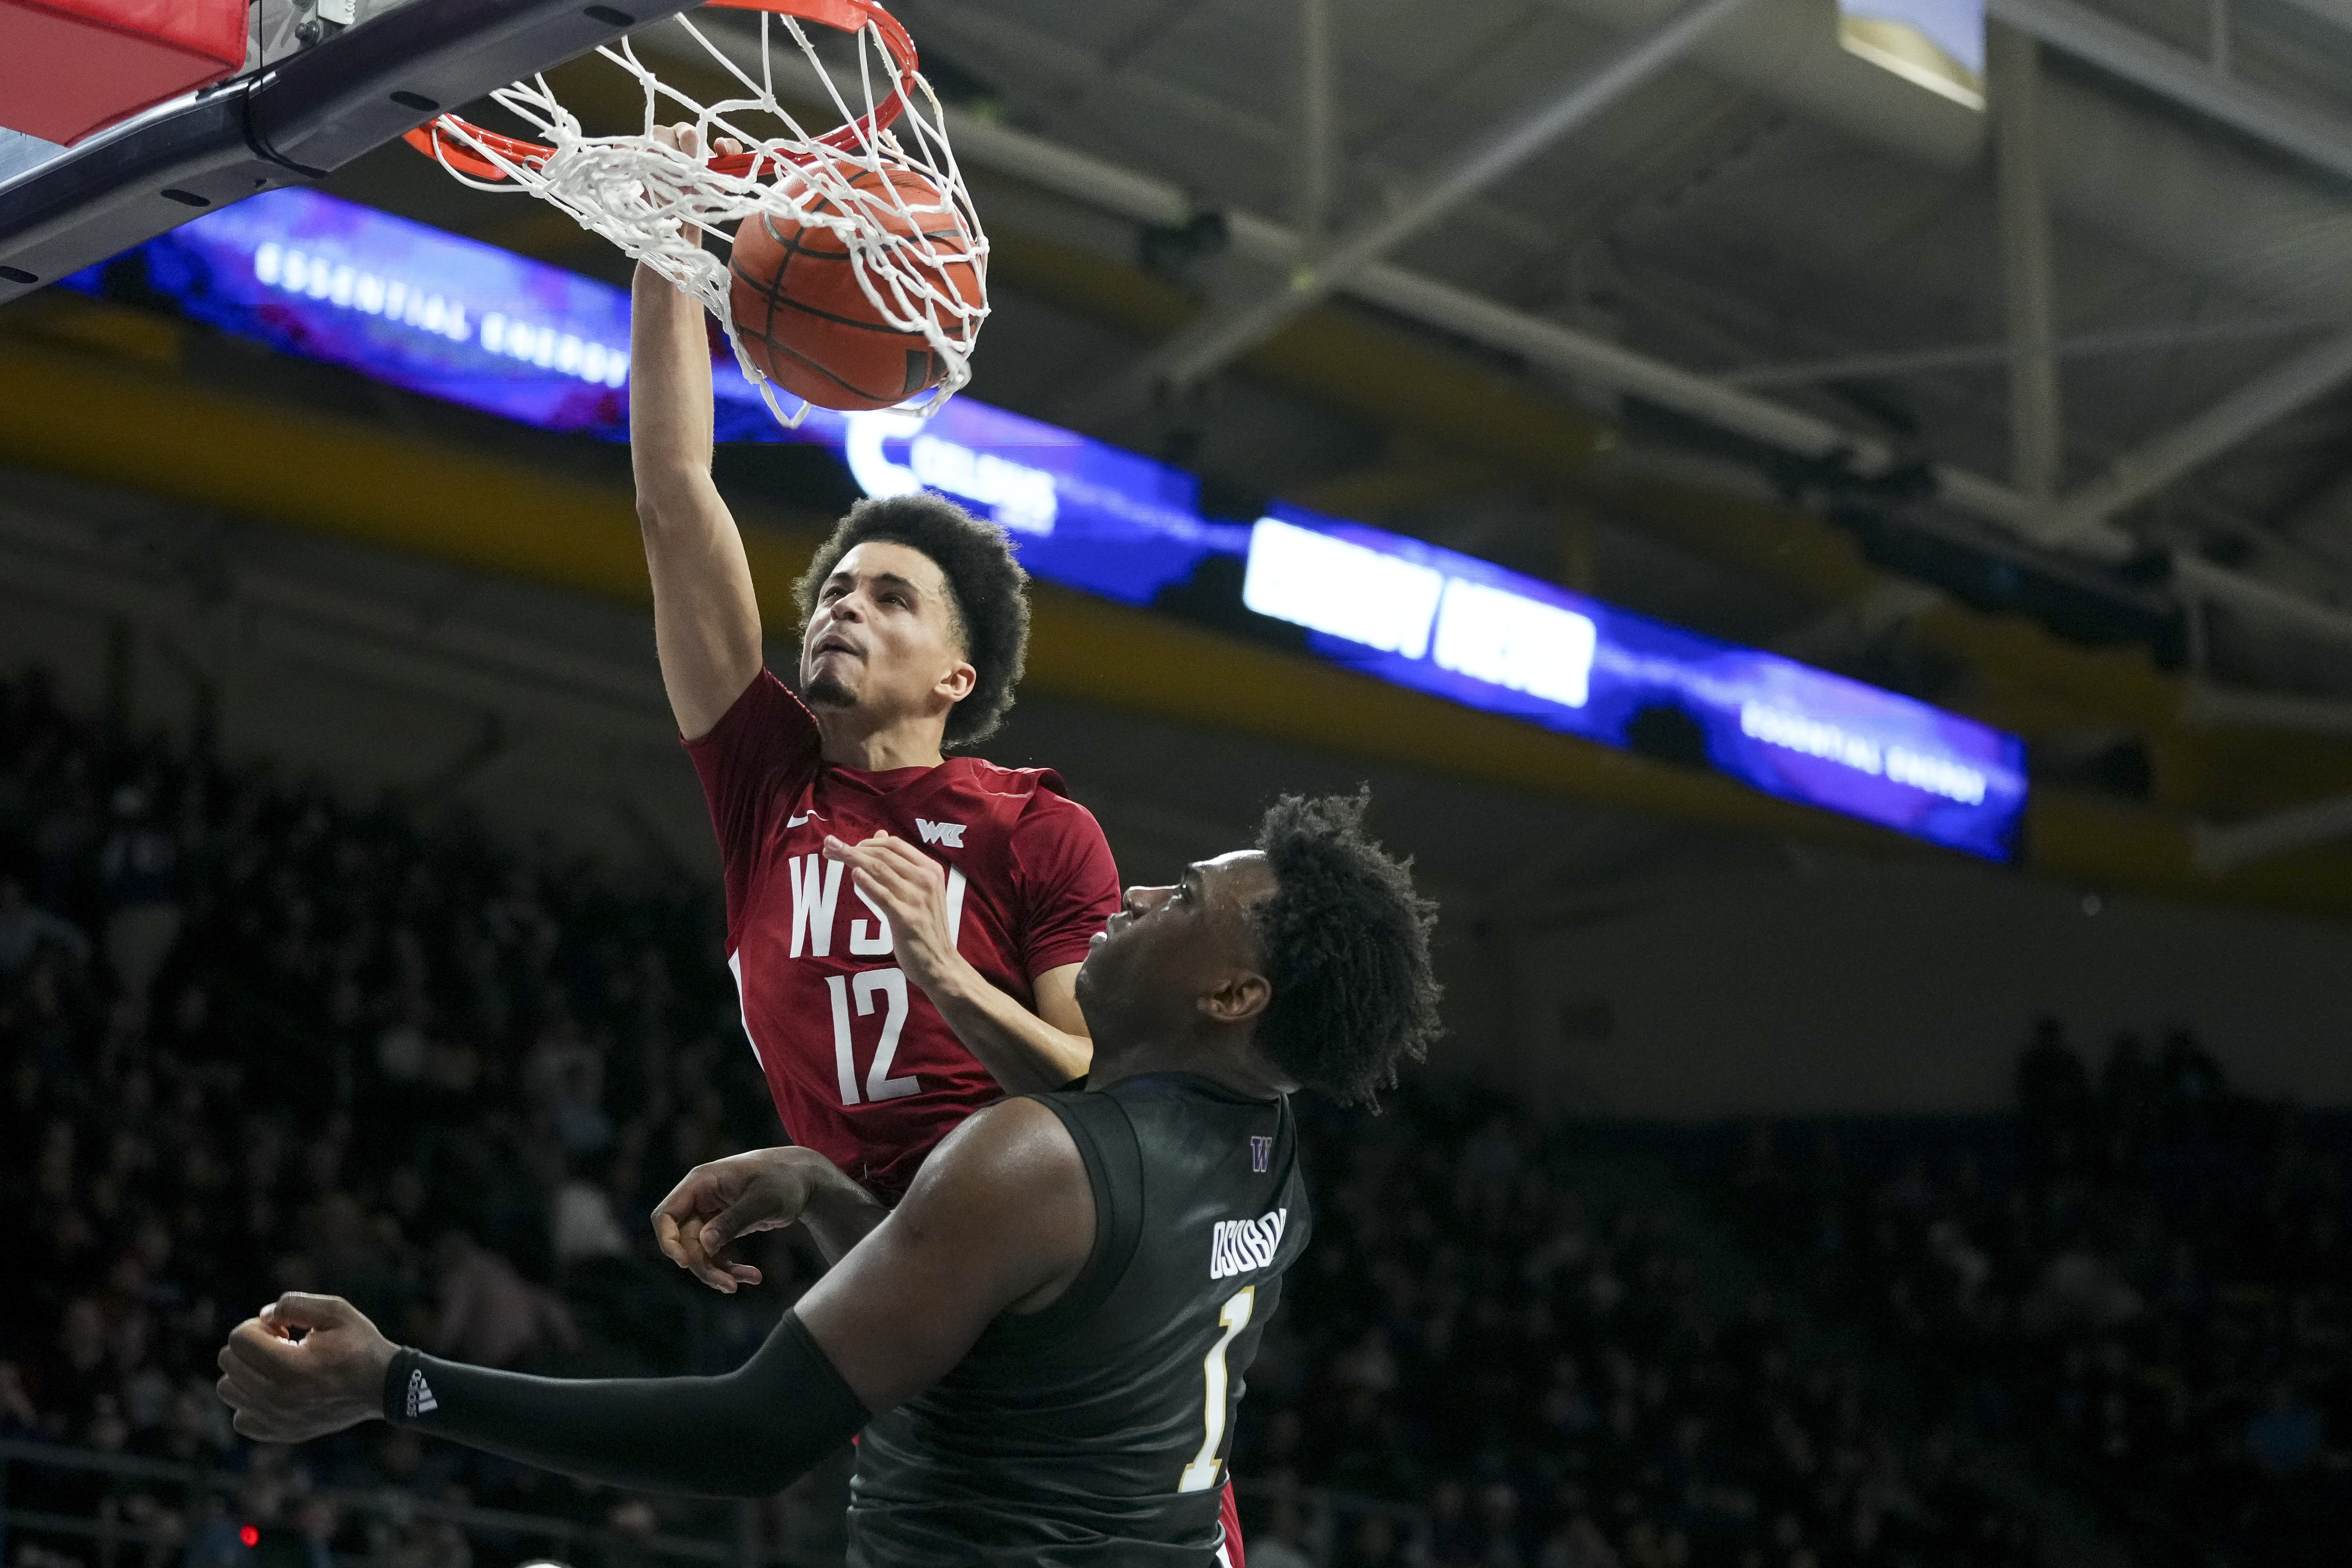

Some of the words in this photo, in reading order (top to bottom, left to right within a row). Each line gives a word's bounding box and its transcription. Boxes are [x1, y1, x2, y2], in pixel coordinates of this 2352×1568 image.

[824, 968, 921, 1106] 12
[1250, 1136, 1272, 1172] W
[407, 1369, 421, 1417] adidas
[1178, 1285, 1255, 1493] 1
